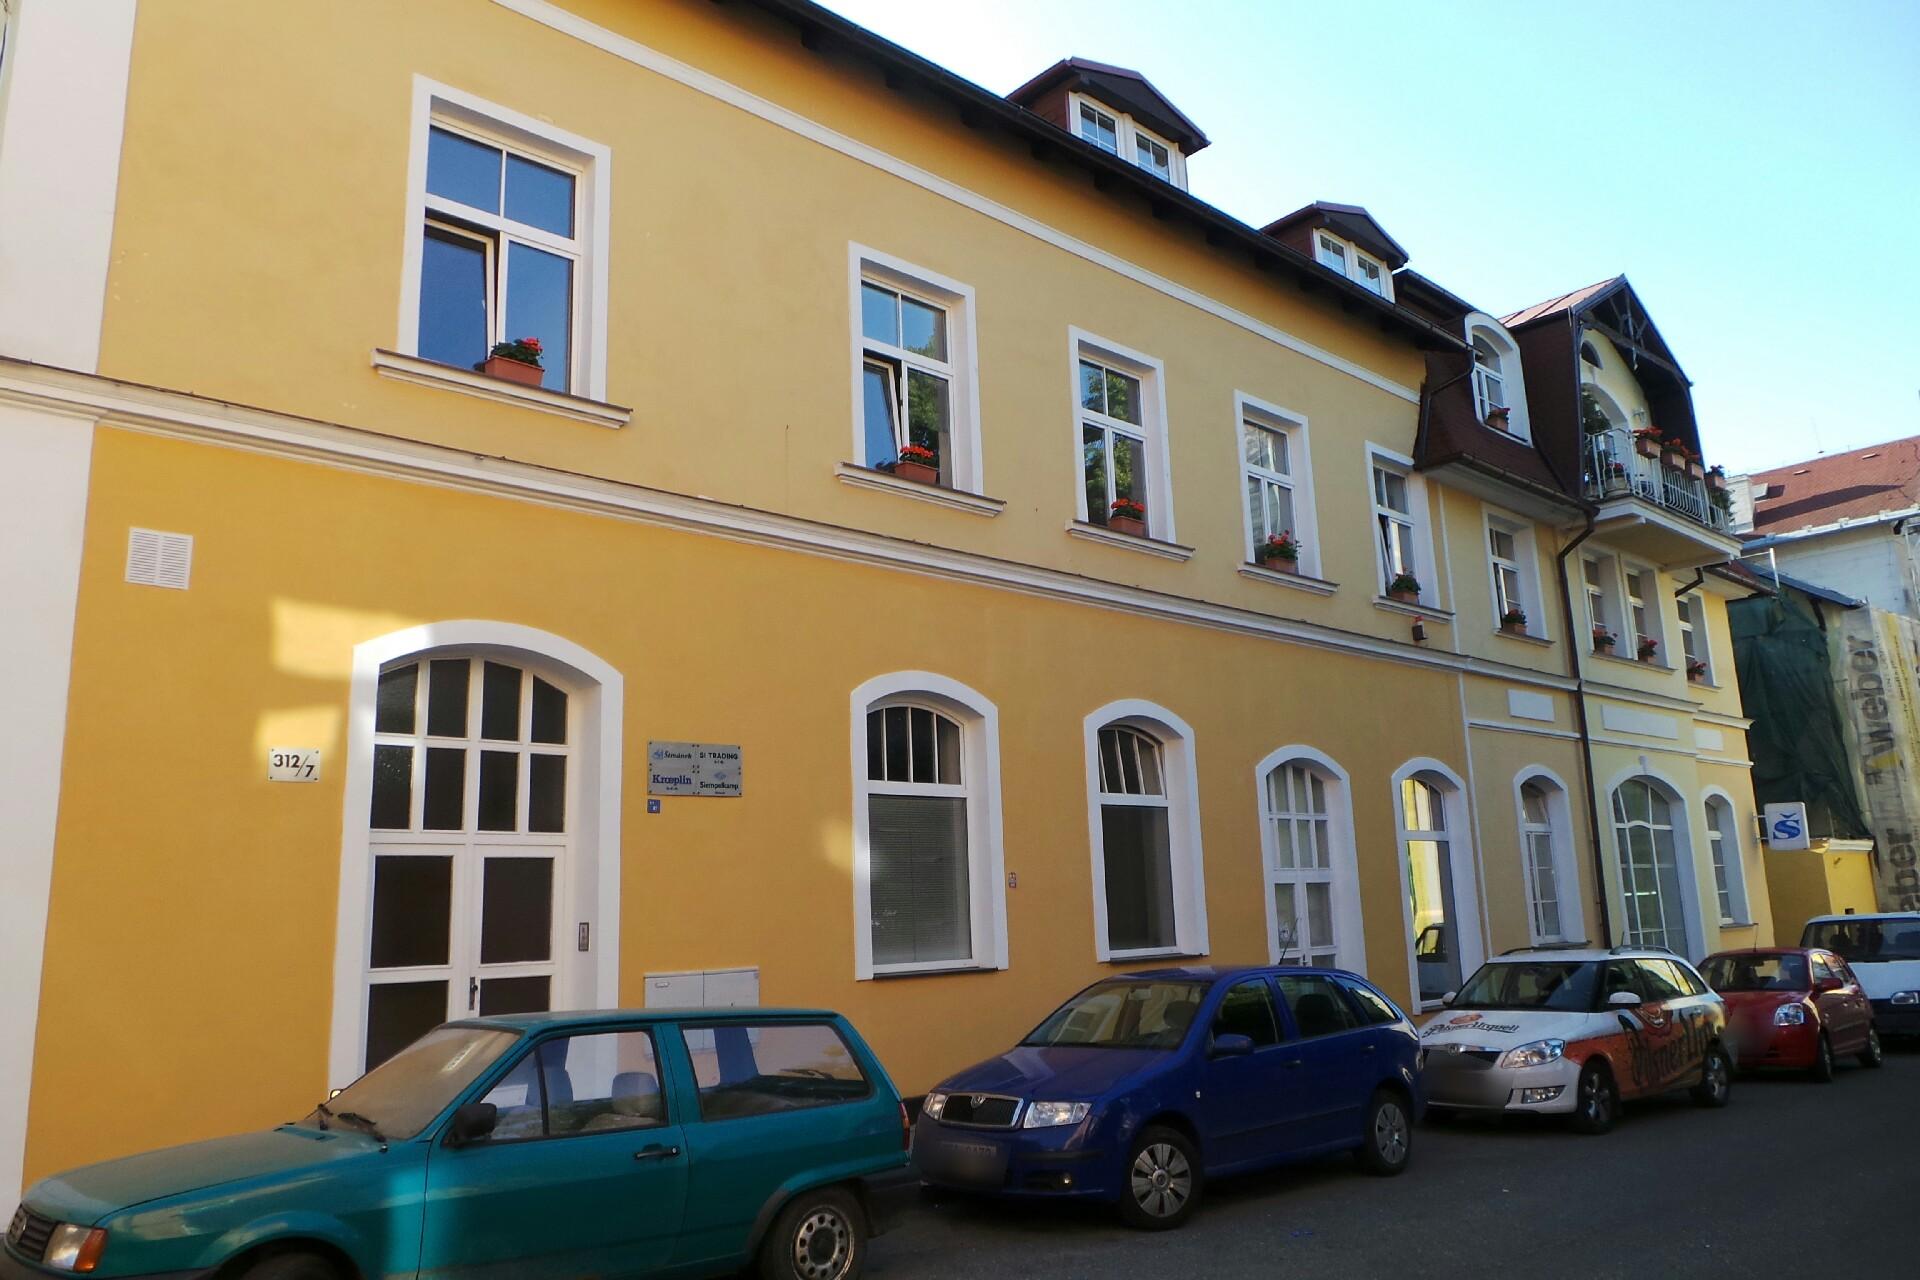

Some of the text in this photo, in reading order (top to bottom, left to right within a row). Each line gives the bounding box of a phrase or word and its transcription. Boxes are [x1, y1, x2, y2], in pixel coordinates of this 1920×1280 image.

[709, 752, 738, 760] TRADING
[273, 754, 315, 777] 312/7
[1773, 813, 1801, 839] Š
[1472, 1021, 1520, 1033] Urquell
